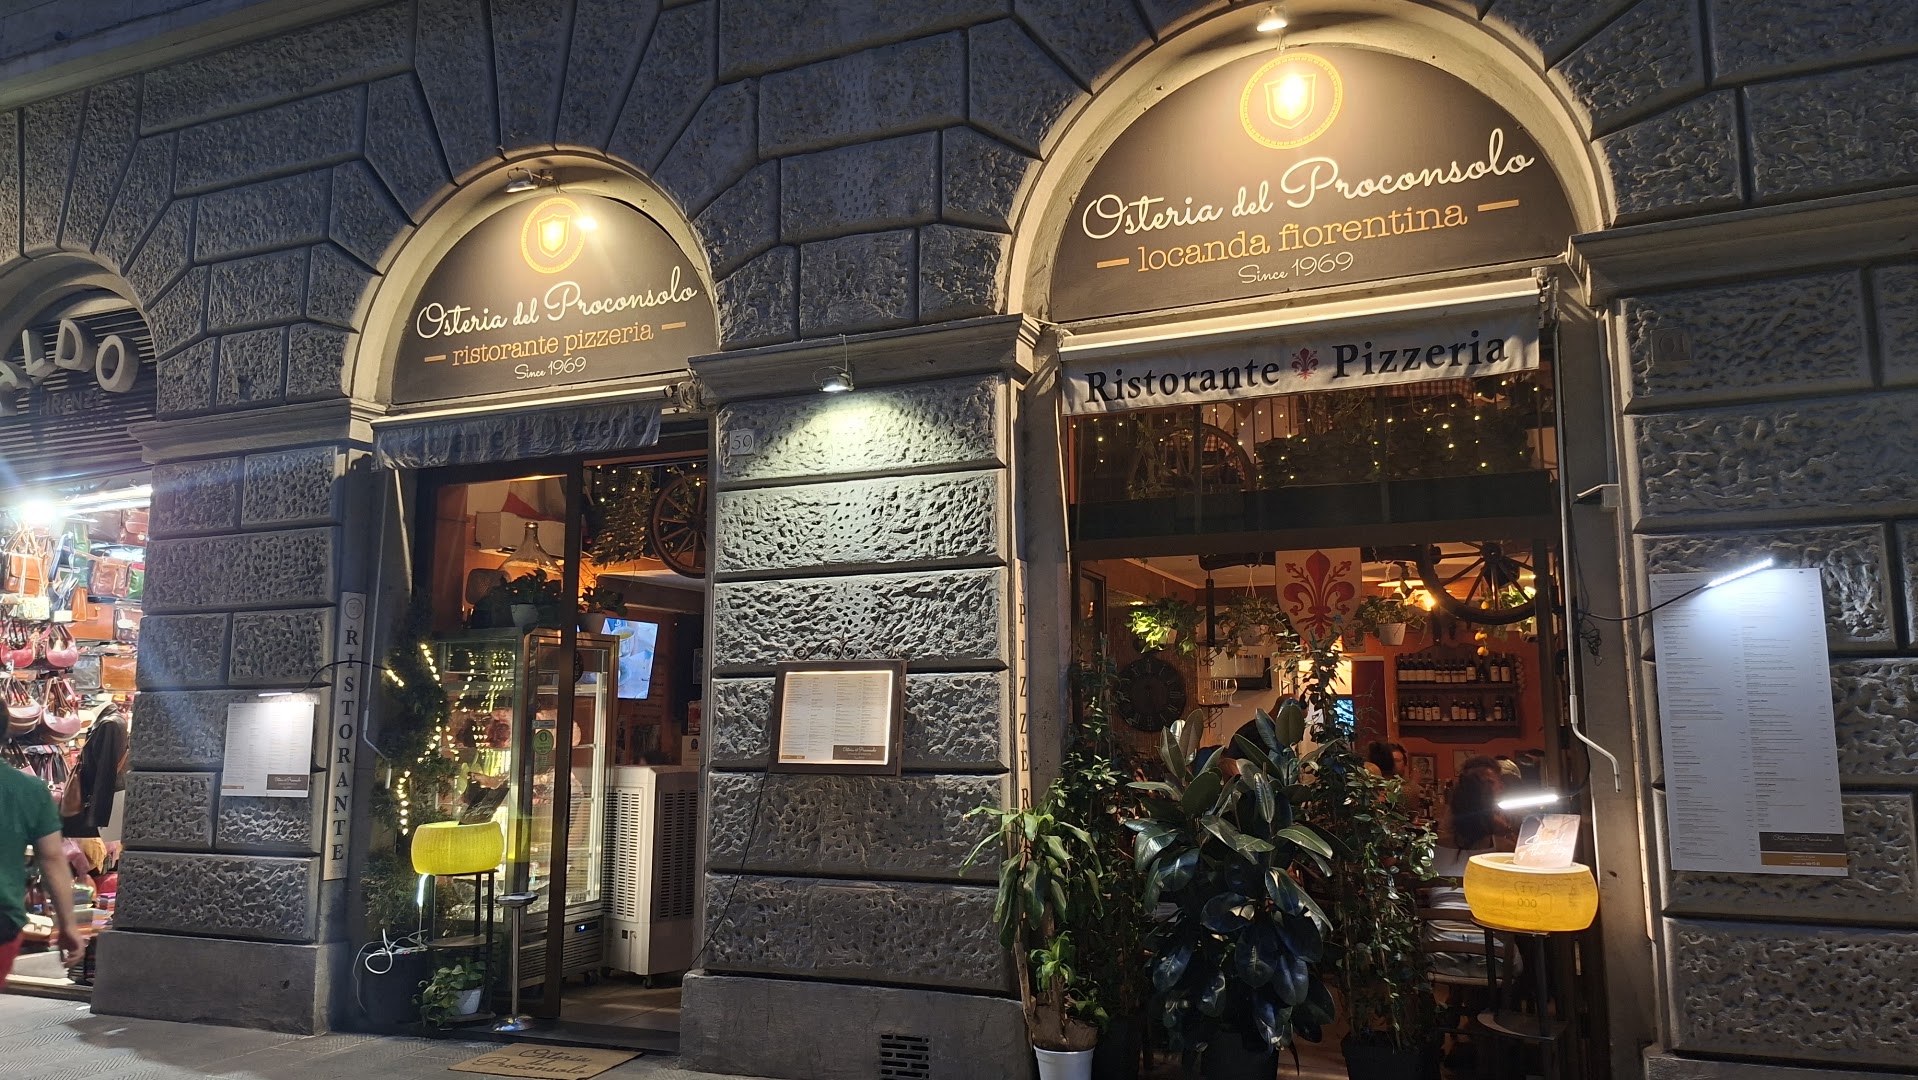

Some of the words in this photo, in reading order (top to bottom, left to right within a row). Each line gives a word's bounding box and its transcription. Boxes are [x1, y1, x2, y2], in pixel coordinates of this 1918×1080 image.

[1082, 194, 1223, 239] Osteria
[1231, 180, 1273, 217] del
[1280, 128, 1535, 208] Proconsolo
[1137, 231, 1270, 272] locanda
[1277, 203, 1468, 252] fiorentina
[1238, 264, 1288, 284] Since
[1291, 251, 1354, 277] 1969
[416, 302, 508, 339] Osteria
[512, 297, 540, 326] del
[543, 265, 698, 321] Proconsolo
[452, 336, 559, 366] ristorante
[563, 321, 654, 356] pizzeria
[514, 363, 546, 380] Since
[548, 356, 587, 376] 1969
[1084, 356, 1281, 403] Ristorante
[1332, 330, 1508, 378] Pizzeria
[732, 435, 753, 453] 59
[331, 629, 359, 861] RISTORANTE
